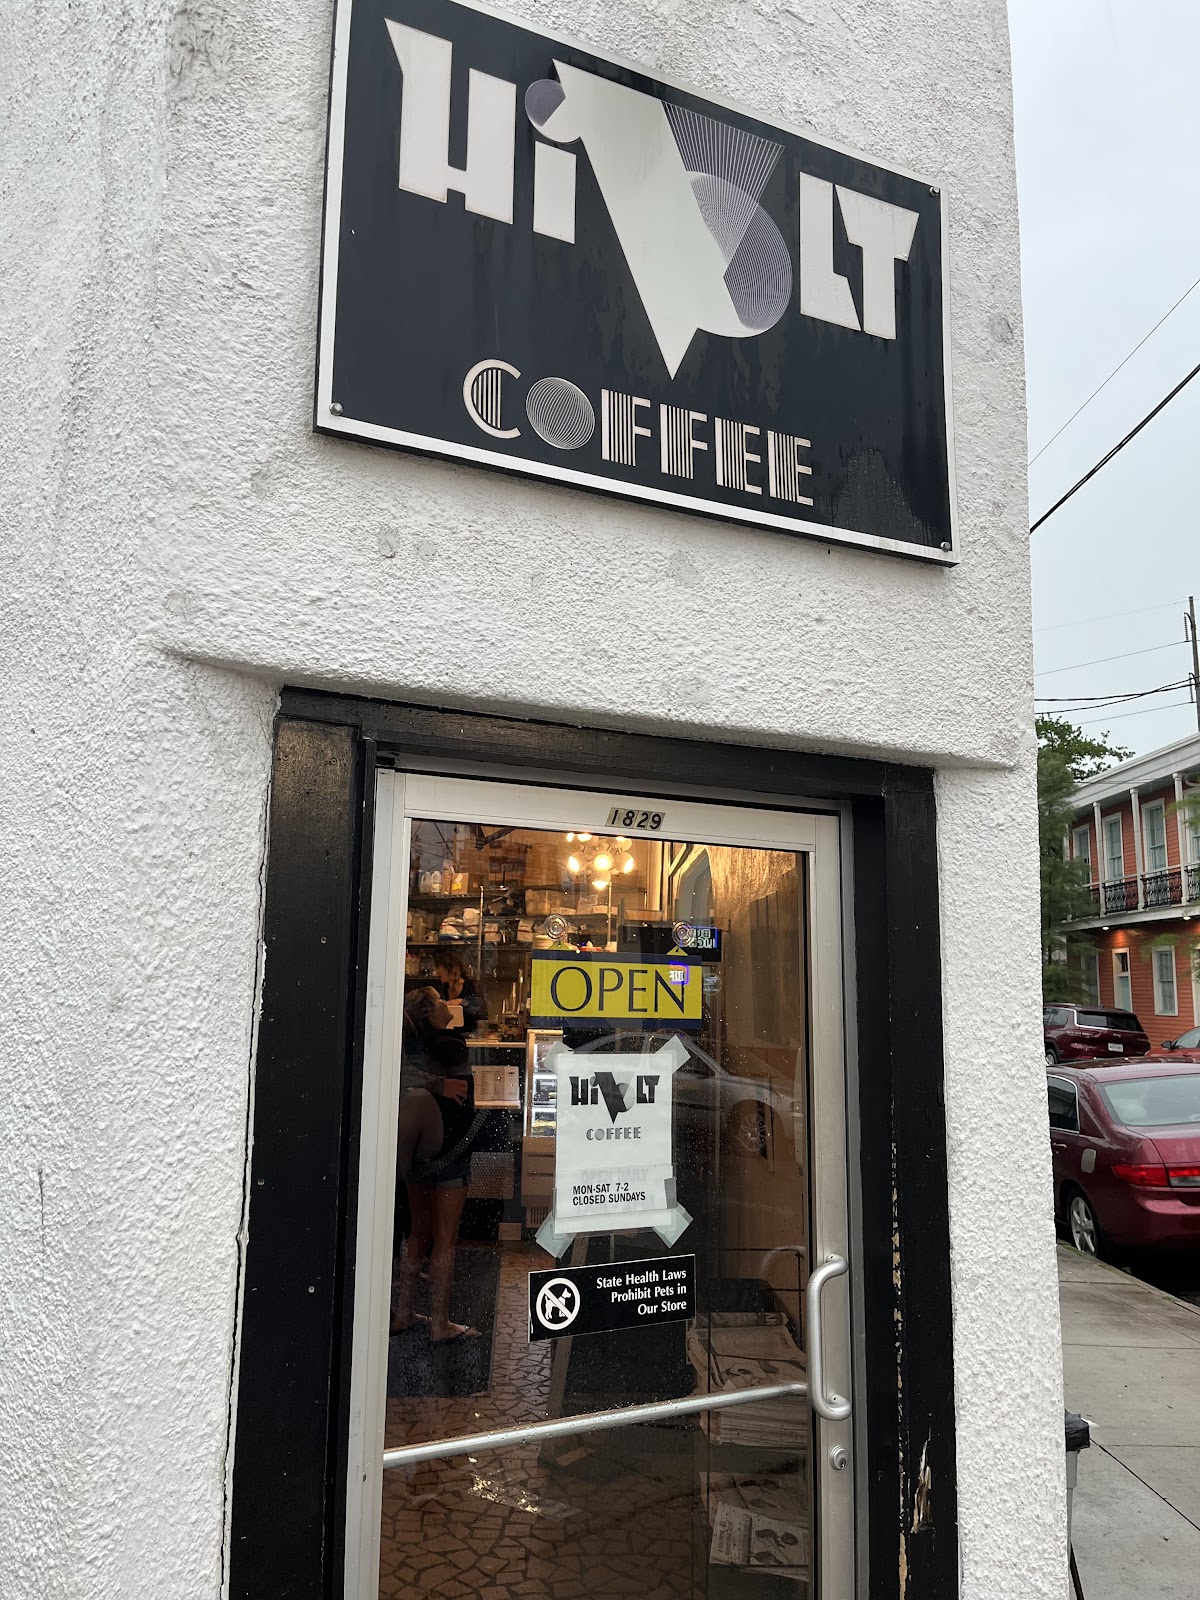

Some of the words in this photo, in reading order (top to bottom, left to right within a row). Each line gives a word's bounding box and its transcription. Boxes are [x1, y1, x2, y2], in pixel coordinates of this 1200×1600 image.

[463, 359, 814, 506] COFFEE
[611, 810, 662, 830] 1829
[550, 966, 685, 1014] OPEN
[586, 1127, 642, 1141] COFFEE
[572, 1195, 606, 1206] CLOSED
[608, 1191, 646, 1203] SUNDAYS
[573, 1183, 611, 1195] MON-SAT
[616, 1182, 629, 1192] 7-2
[596, 1276, 623, 1289] State
[625, 1270, 659, 1285] Health
[662, 1269, 687, 1281] Laws
[611, 1286, 652, 1303] Prohibit
[654, 1285, 674, 1298] Pets
[677, 1282, 687, 1295] in
[637, 1303, 658, 1315] Our
[661, 1300, 687, 1313] Store
